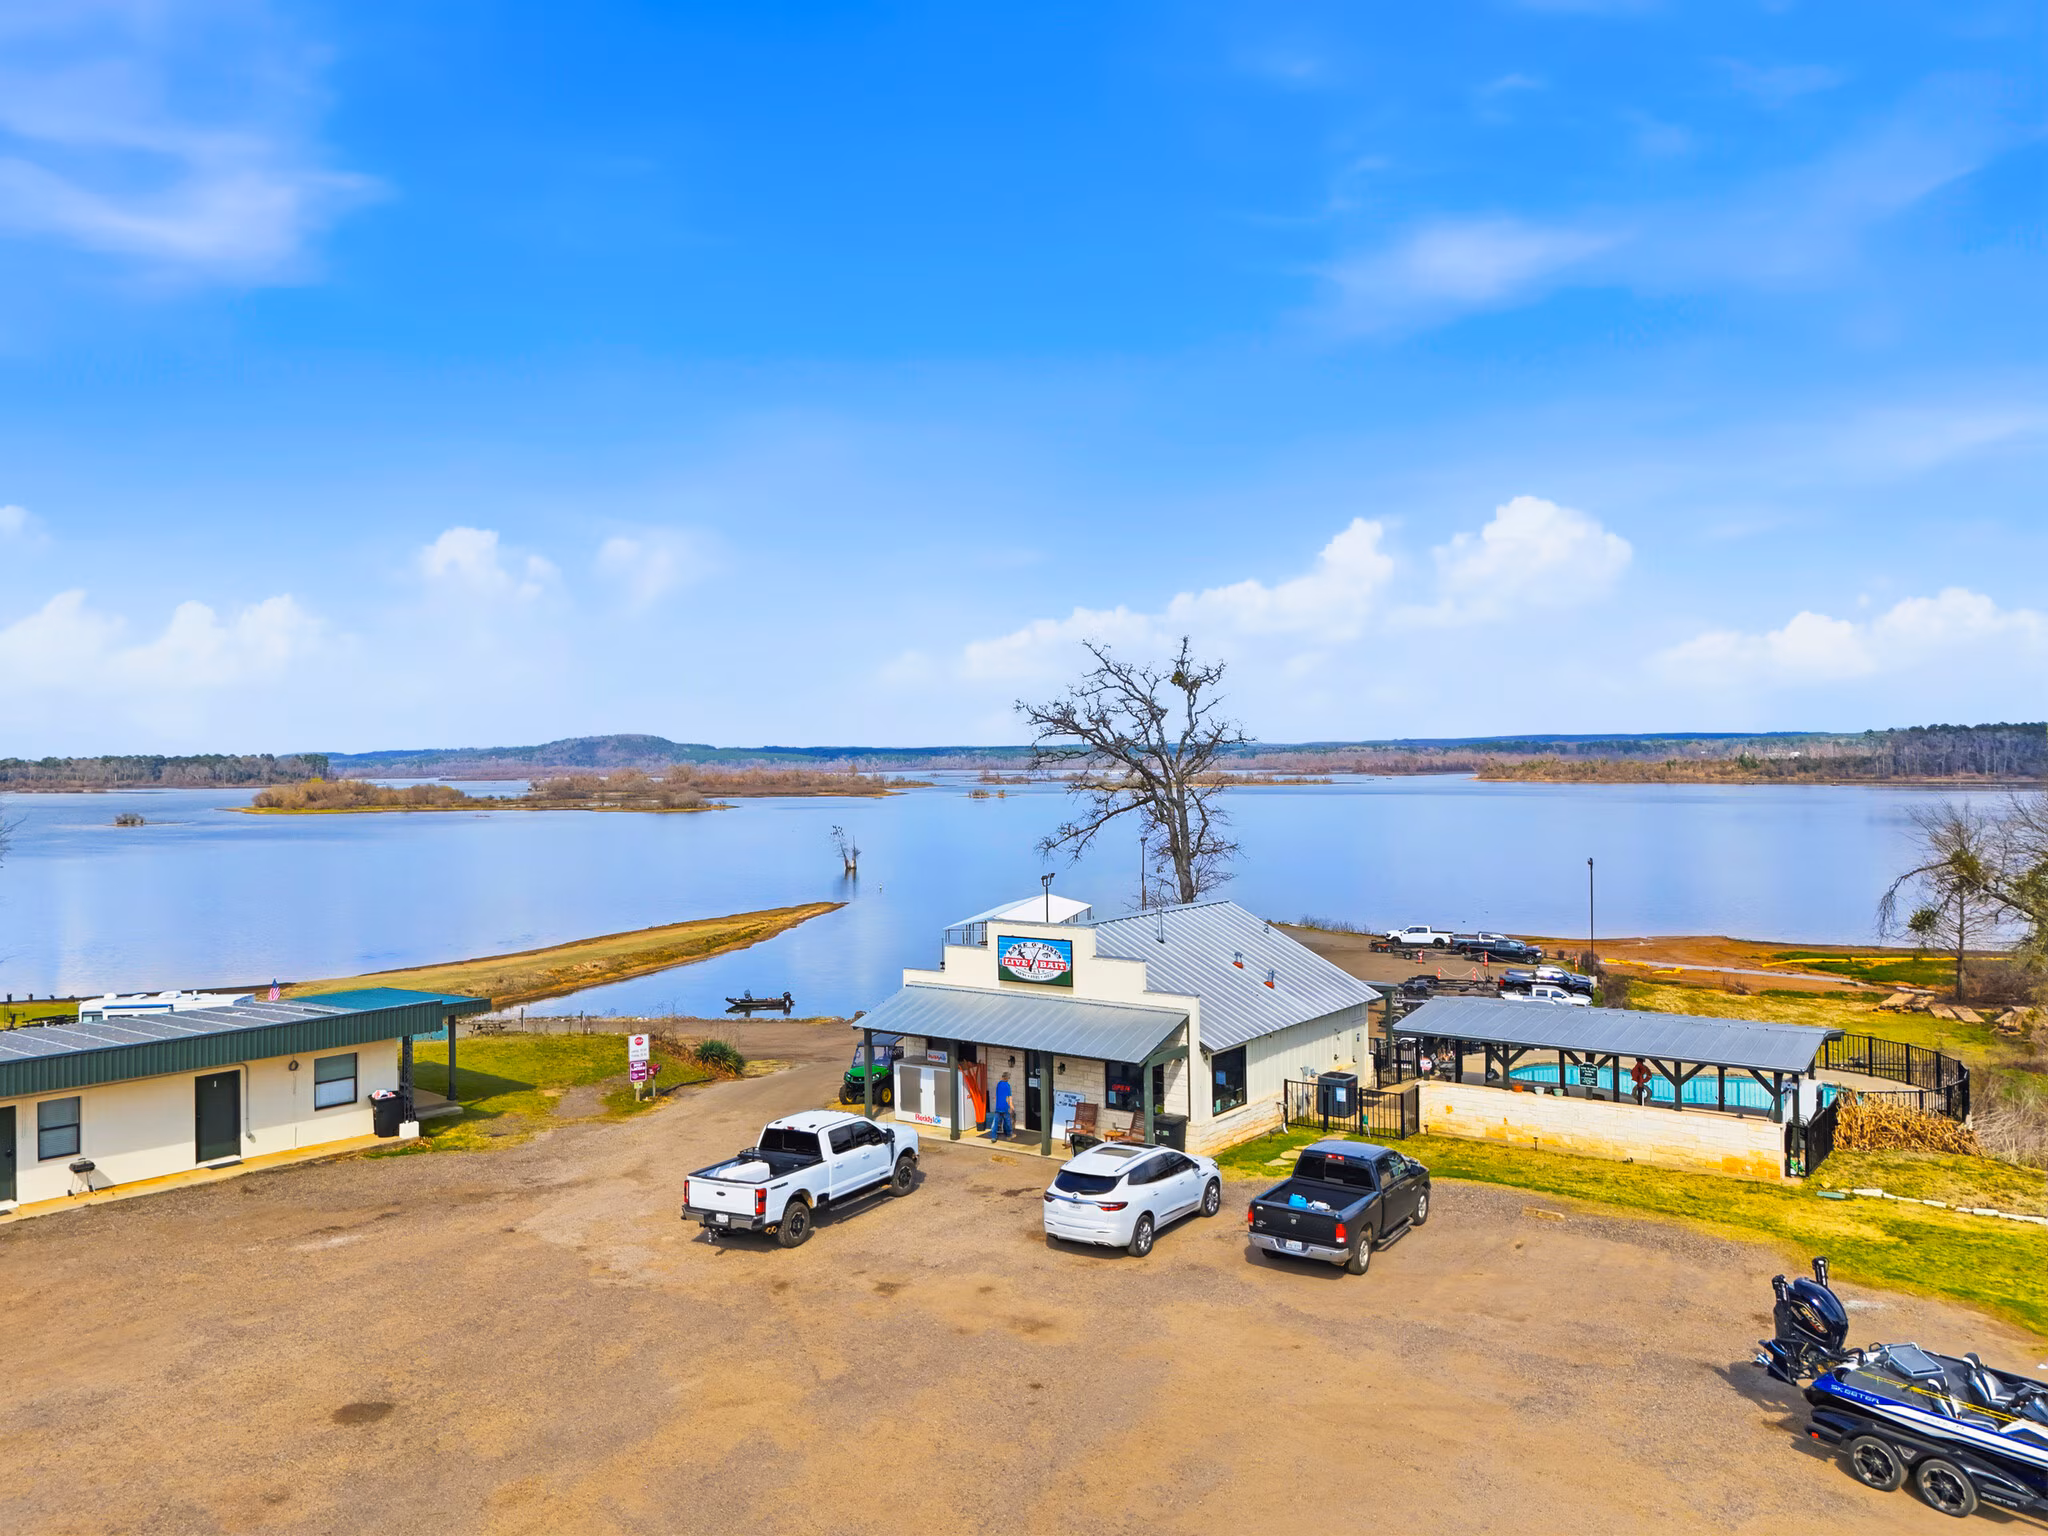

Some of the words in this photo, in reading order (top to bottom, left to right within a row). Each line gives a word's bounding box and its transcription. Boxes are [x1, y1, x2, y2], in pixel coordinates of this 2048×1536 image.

[1008, 942, 1028, 955] LAKE
[1004, 958, 1028, 967] LIVE
[1039, 960, 1066, 970] BAIT
[1112, 1084, 1130, 1092] OPEN
[1831, 1384, 1880, 1404] SKEETER
